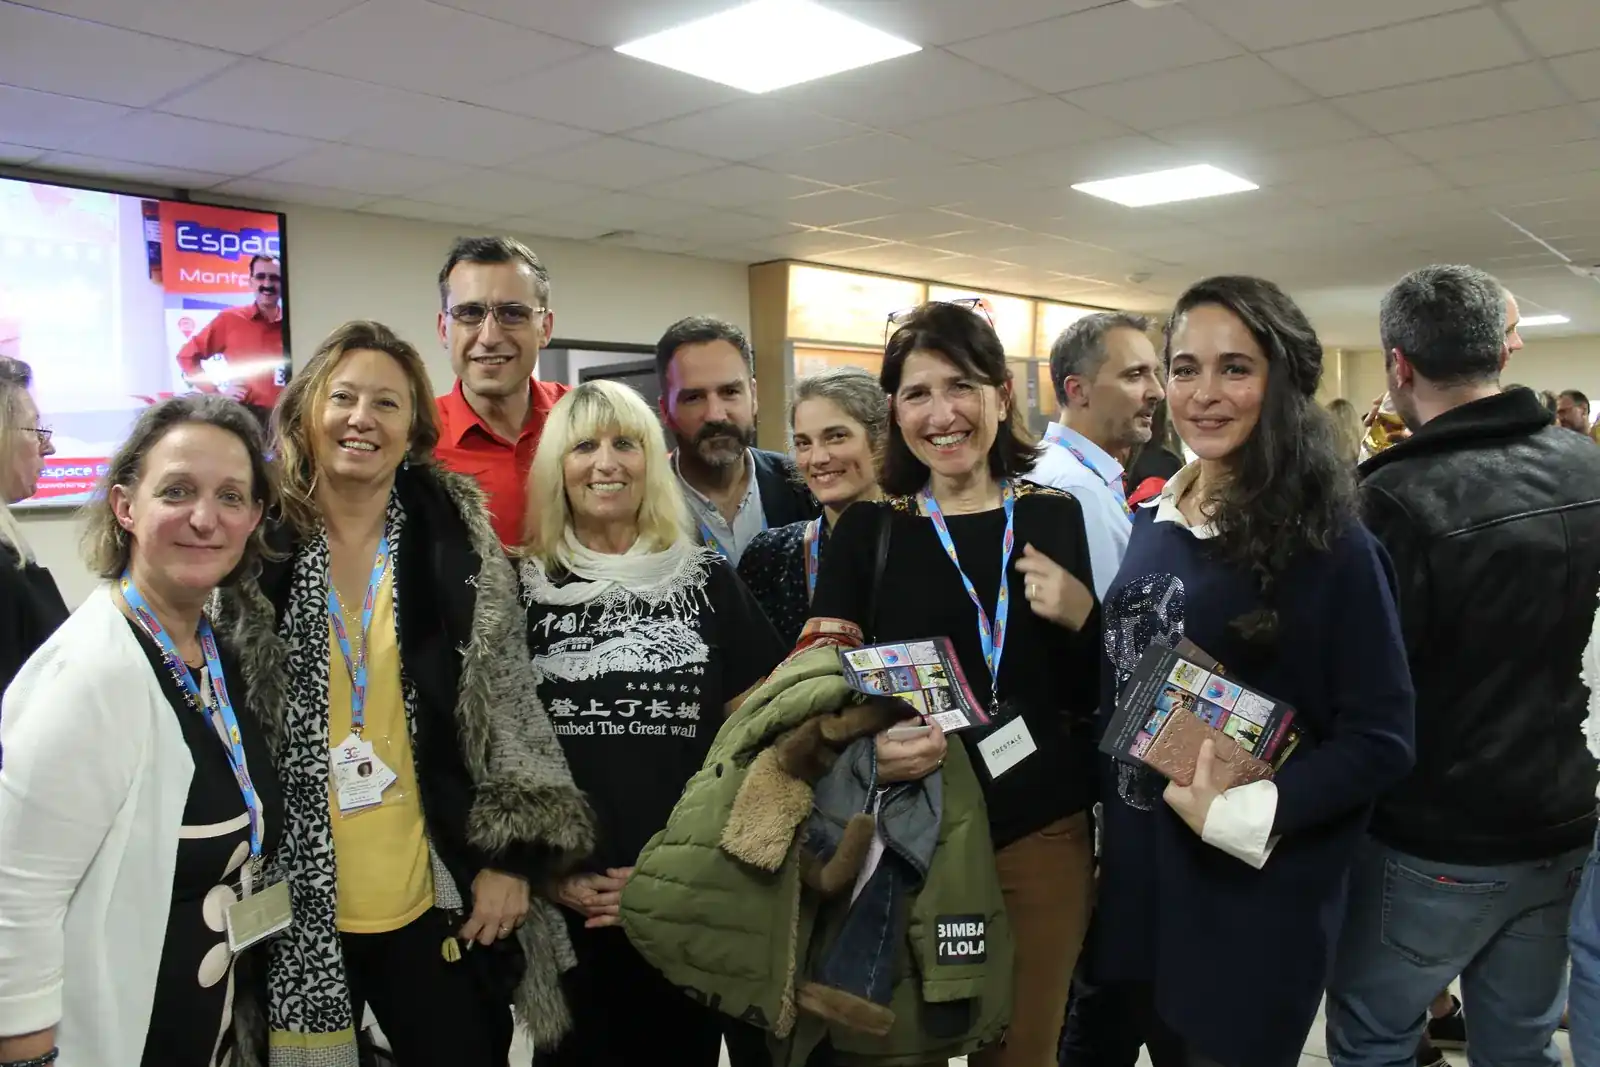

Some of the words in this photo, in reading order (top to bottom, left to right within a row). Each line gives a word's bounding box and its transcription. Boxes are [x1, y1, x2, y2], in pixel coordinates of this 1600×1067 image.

[553, 721, 595, 735] imbed
[598, 721, 625, 735] The
[629, 721, 667, 736] Great
[670, 724, 697, 738] wall
[937, 922, 985, 938] BIMBA
[947, 940, 985, 956] LOLA
